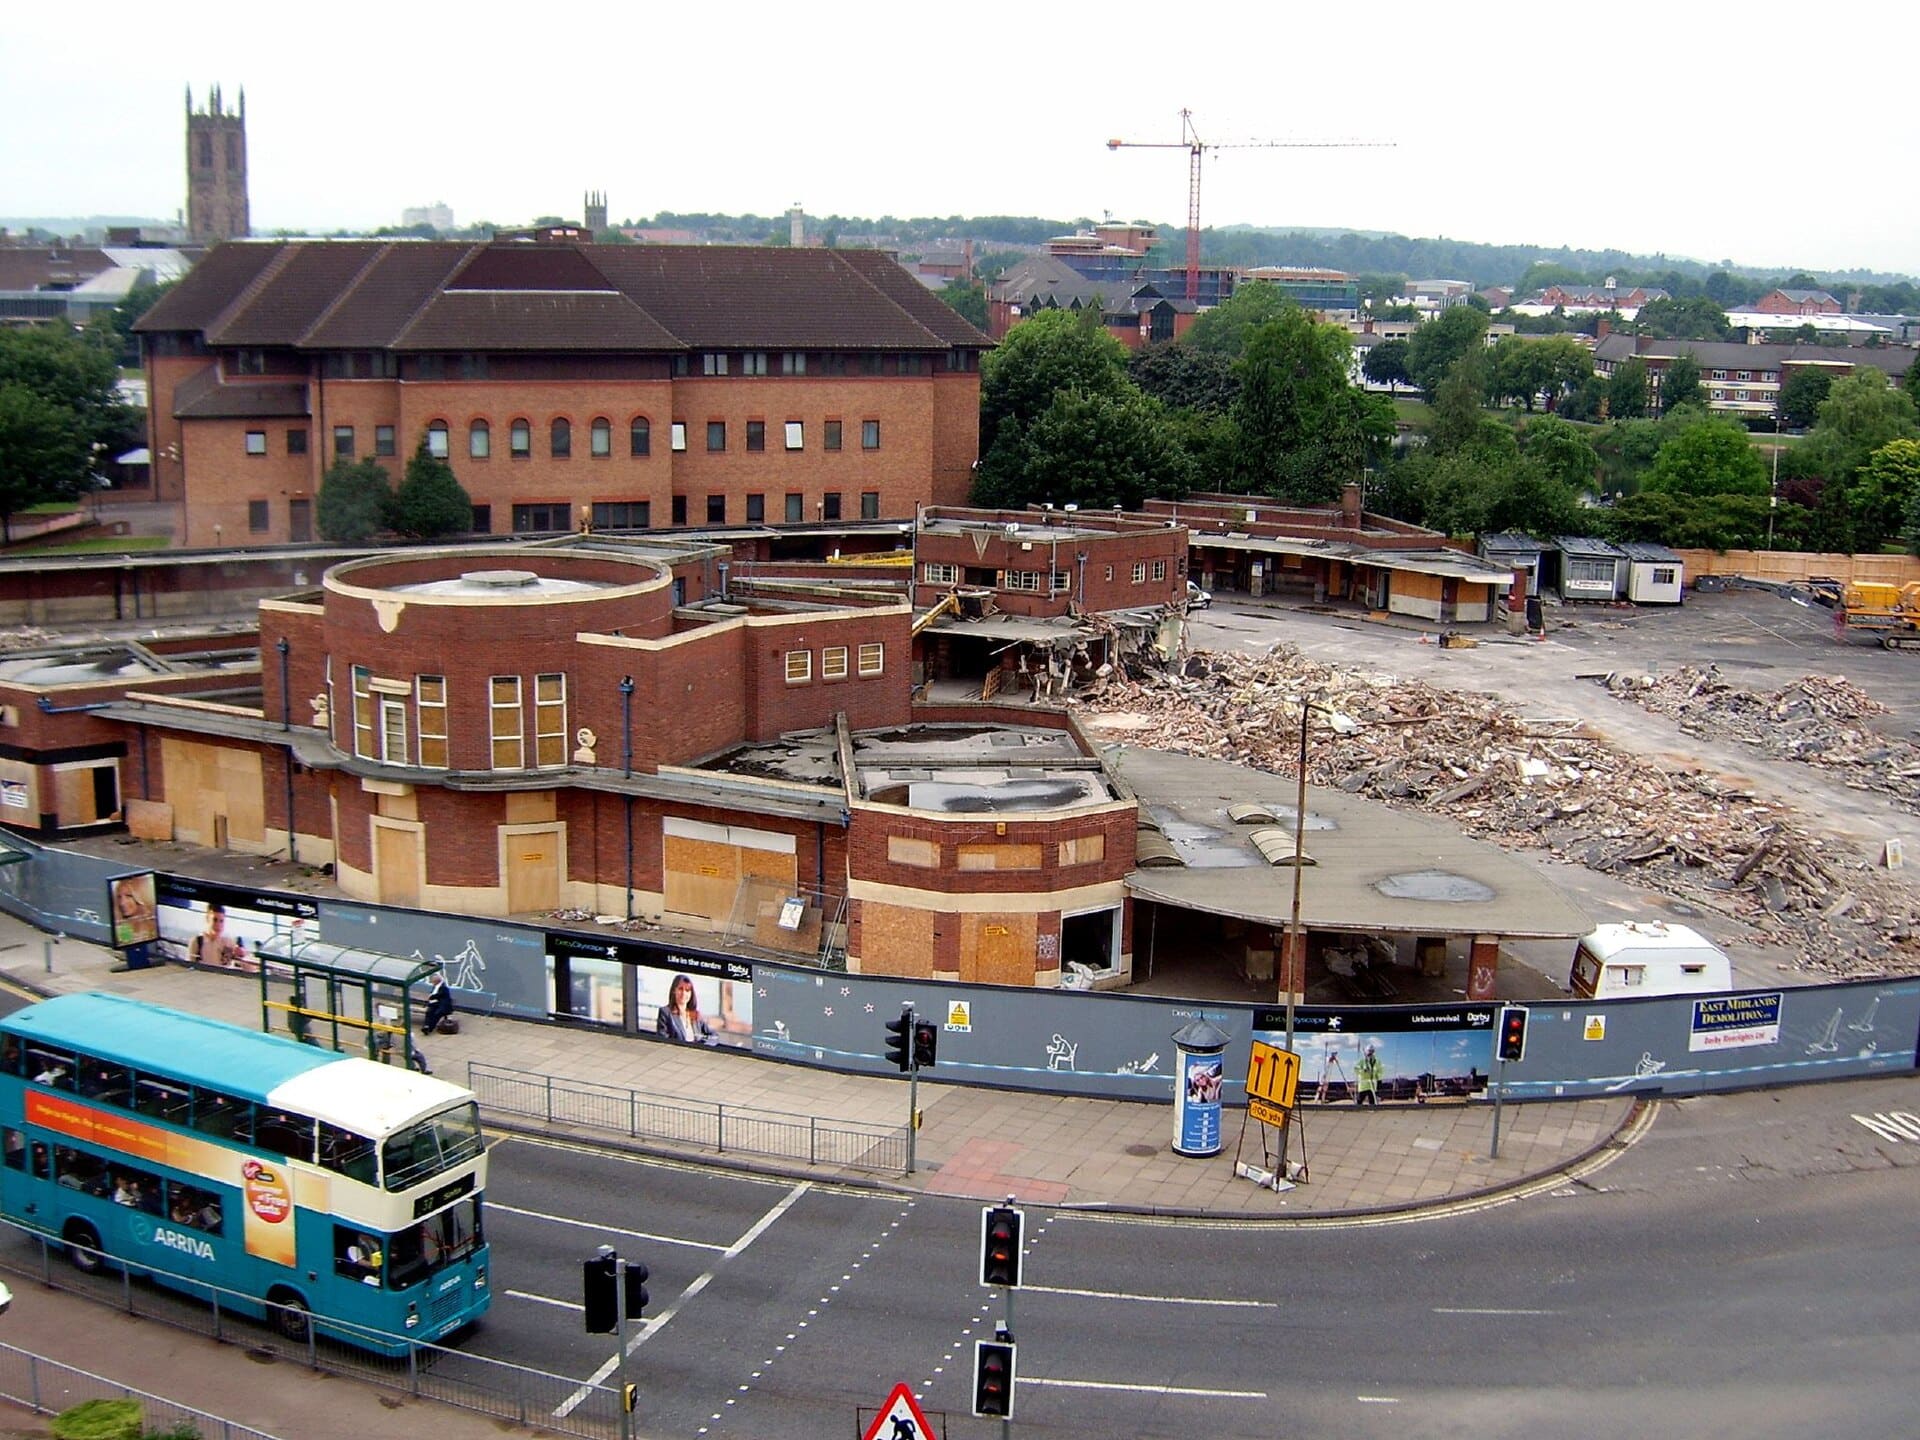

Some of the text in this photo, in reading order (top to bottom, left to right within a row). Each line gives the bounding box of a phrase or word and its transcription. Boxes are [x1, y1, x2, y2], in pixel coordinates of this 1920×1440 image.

[667, 955, 679, 963] Life
[688, 958, 699, 966] the
[700, 960, 722, 970] centre
[1699, 997, 1778, 1012] EAST MIDLANDS
[1411, 1014, 1460, 1023] Urban revival
[1702, 1009, 1764, 1024] DEMOLITION
[153, 1227, 216, 1262] ARRIVA
